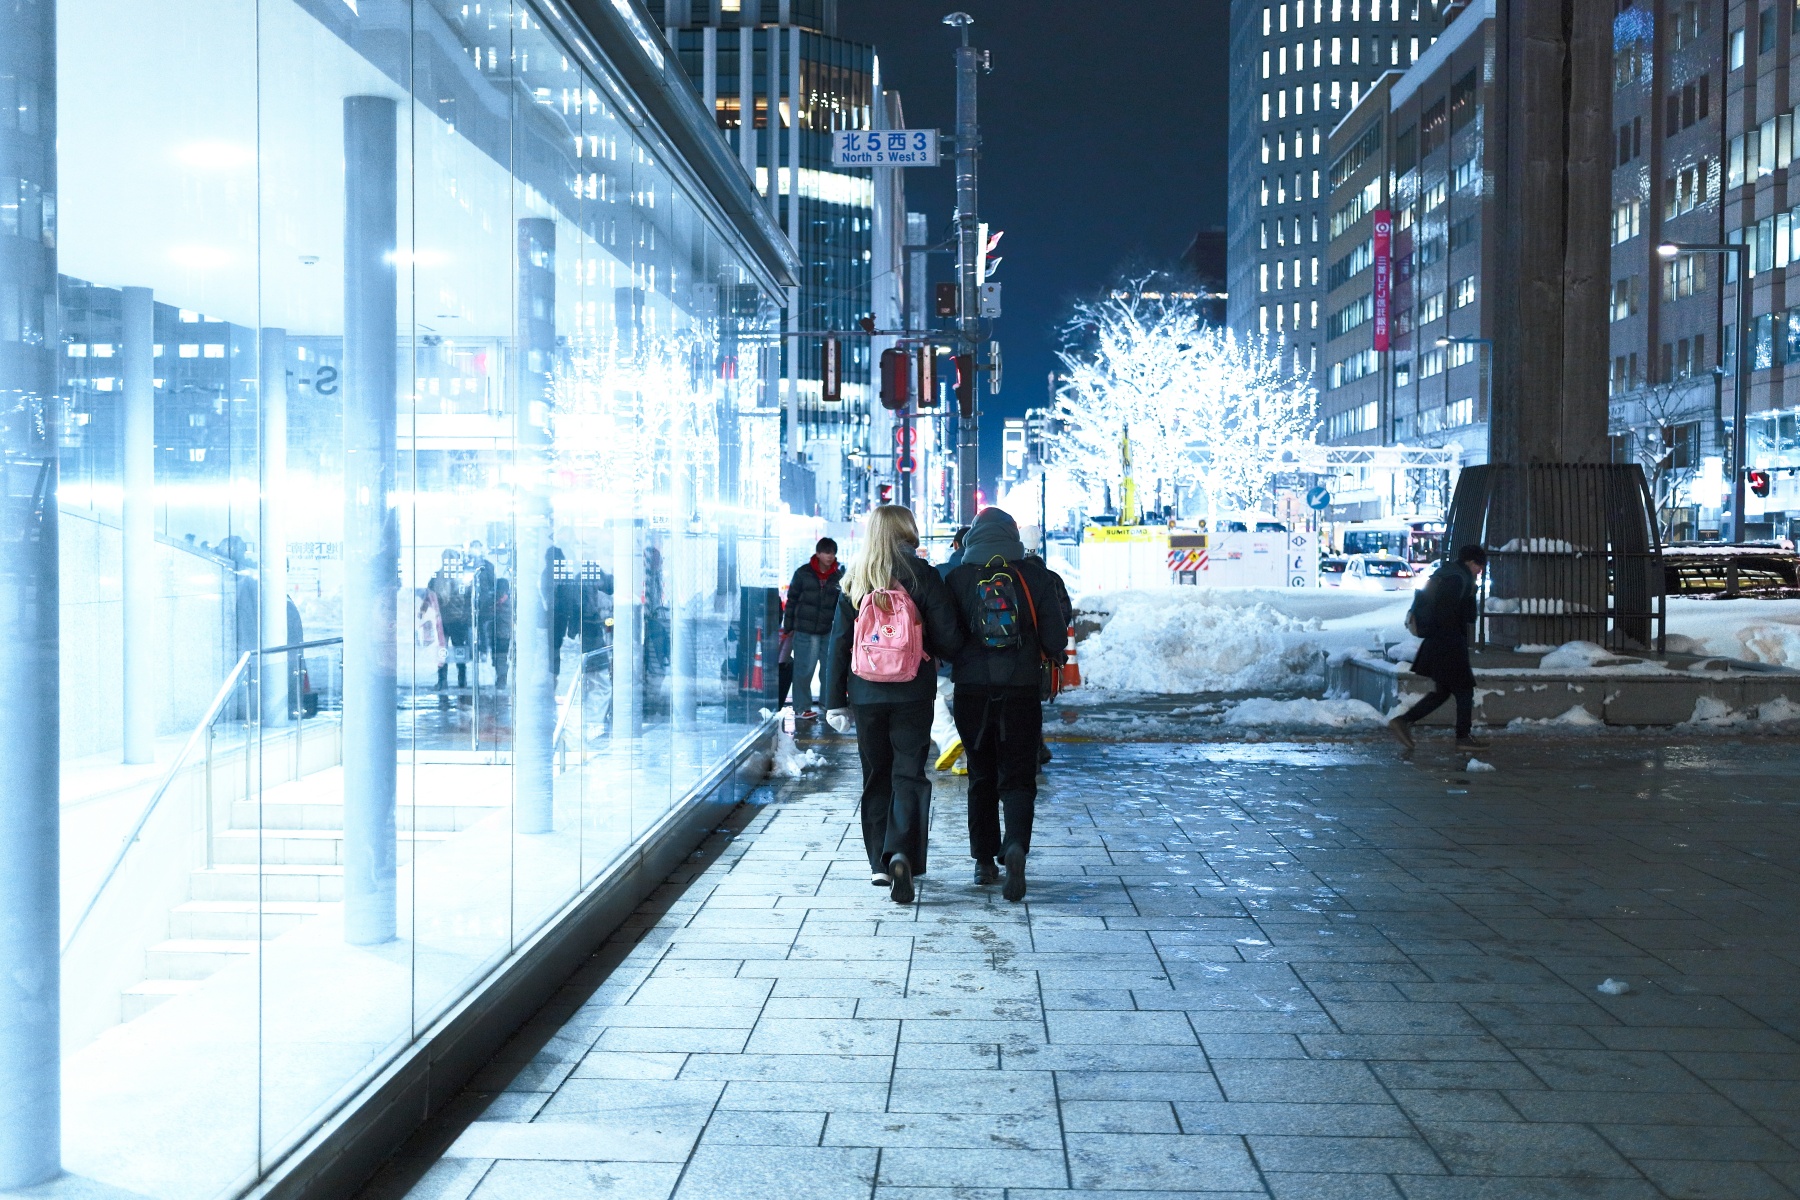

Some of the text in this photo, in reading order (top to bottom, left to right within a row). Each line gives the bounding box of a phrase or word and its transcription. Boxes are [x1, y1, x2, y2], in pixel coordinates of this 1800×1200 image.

[842, 152, 927, 162] North 5 West 3
